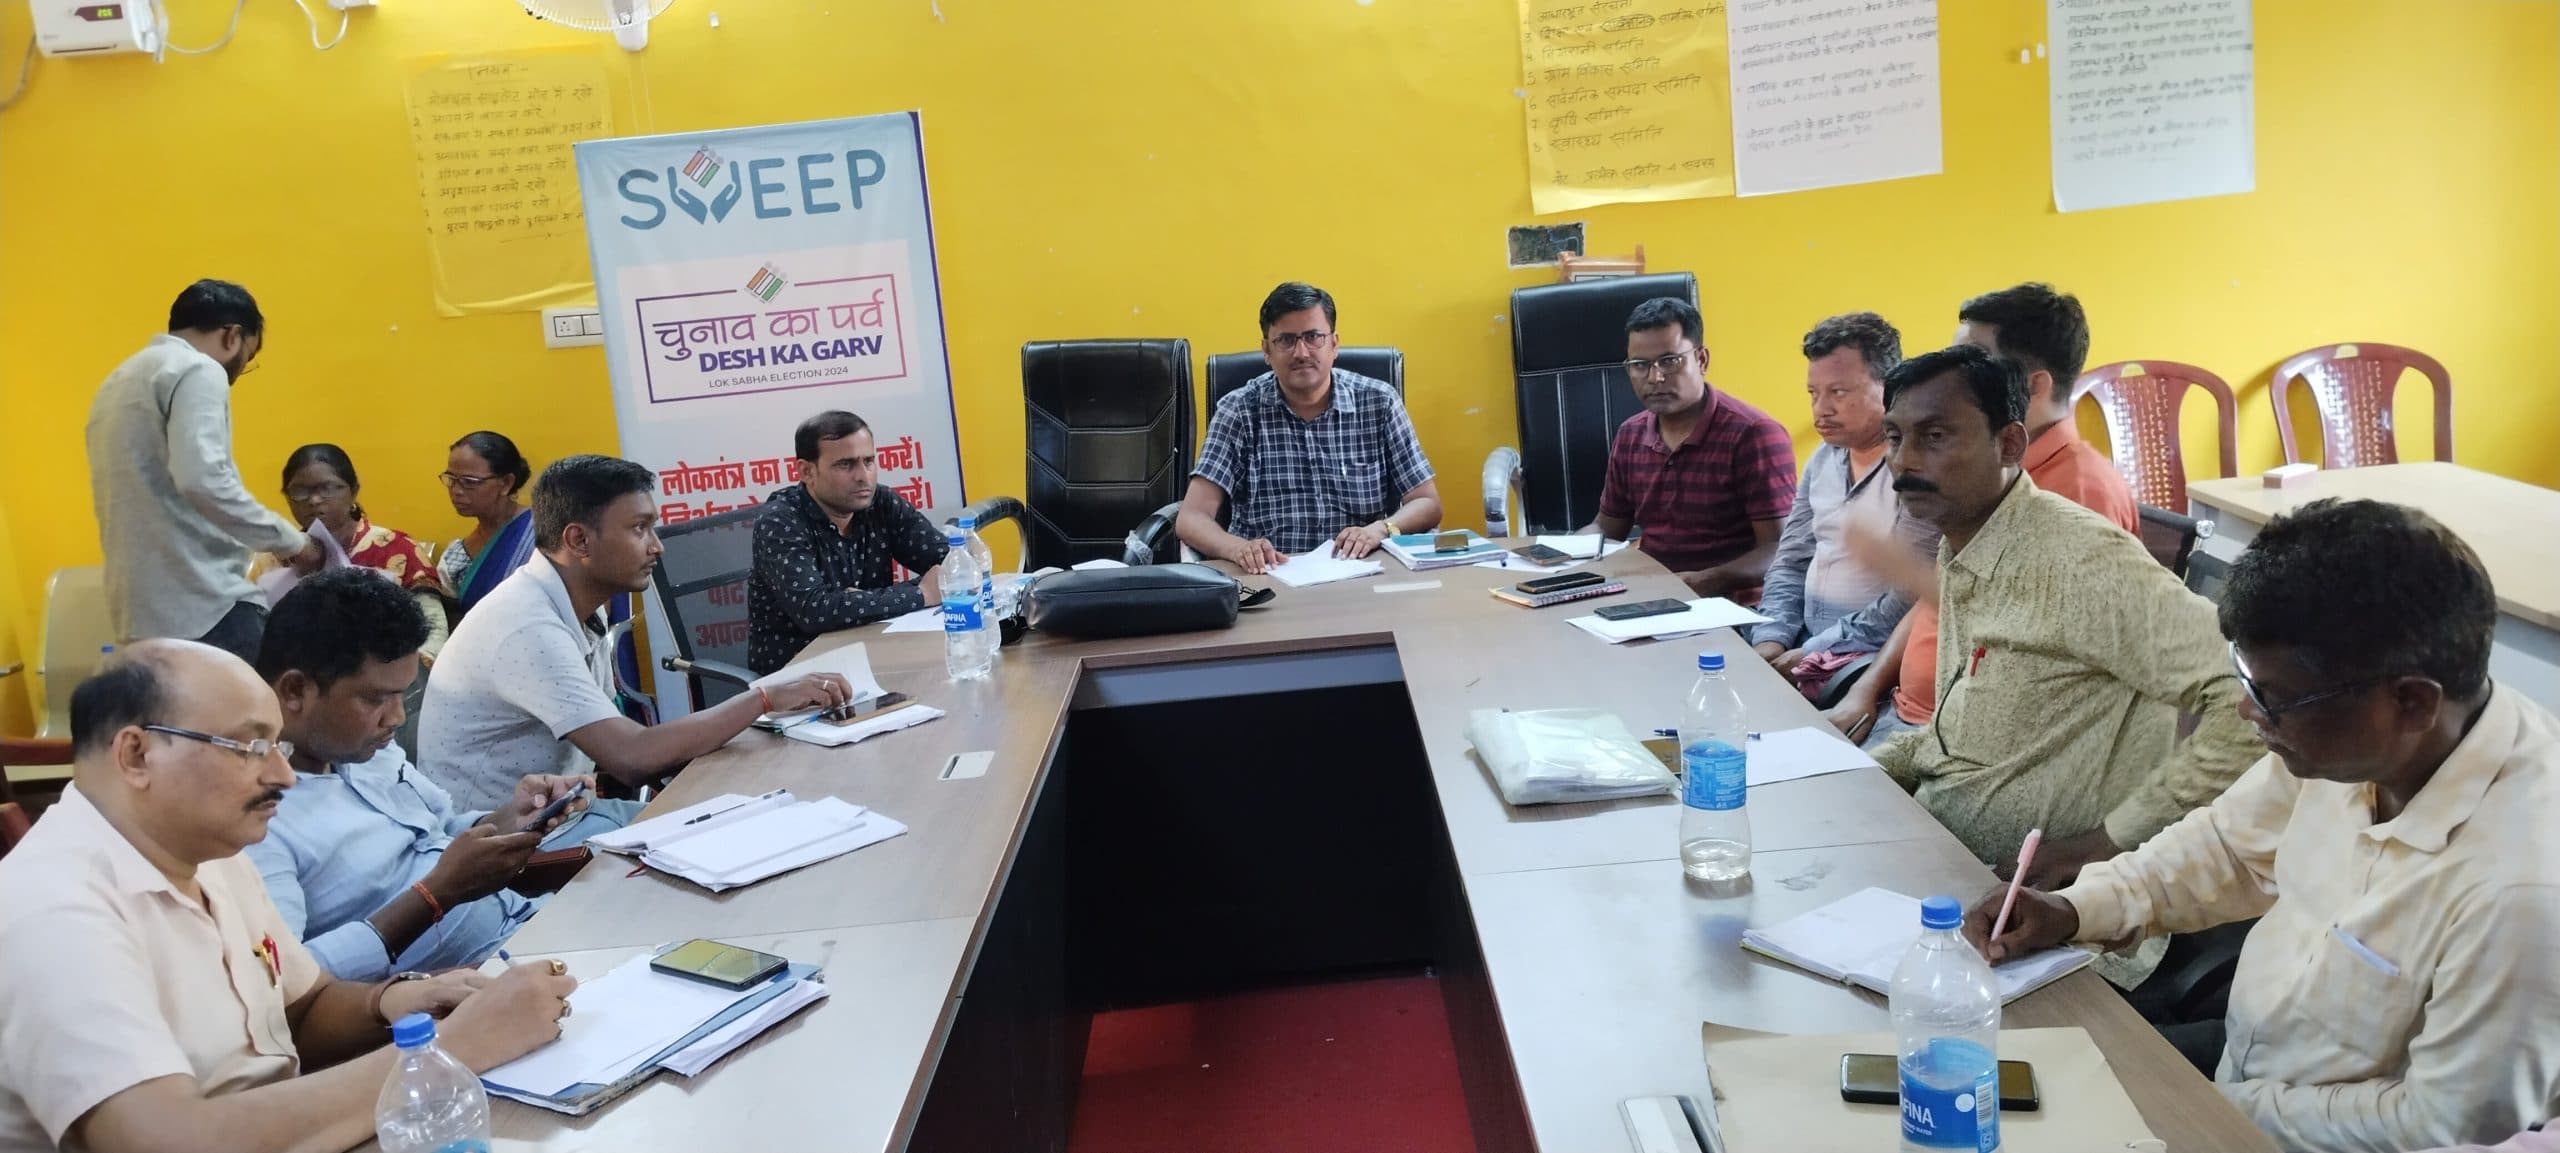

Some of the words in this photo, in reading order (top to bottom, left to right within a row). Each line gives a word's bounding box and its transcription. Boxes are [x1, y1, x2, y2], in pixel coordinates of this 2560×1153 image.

[617, 148, 887, 231] SWEEP
[652, 313, 757, 362] चुनाव
[765, 307, 820, 337] का
[827, 288, 886, 330] पर्व
[699, 346, 766, 373] DESH
[771, 342, 808, 366] KA
[811, 334, 884, 360] GARV
[709, 378, 730, 388] LOK
[731, 375, 768, 386] SABHA
[770, 369, 822, 382] ELECTION
[824, 366, 849, 377] 2024
[659, 456, 746, 496] लोकतंत्र
[749, 458, 781, 486] का
